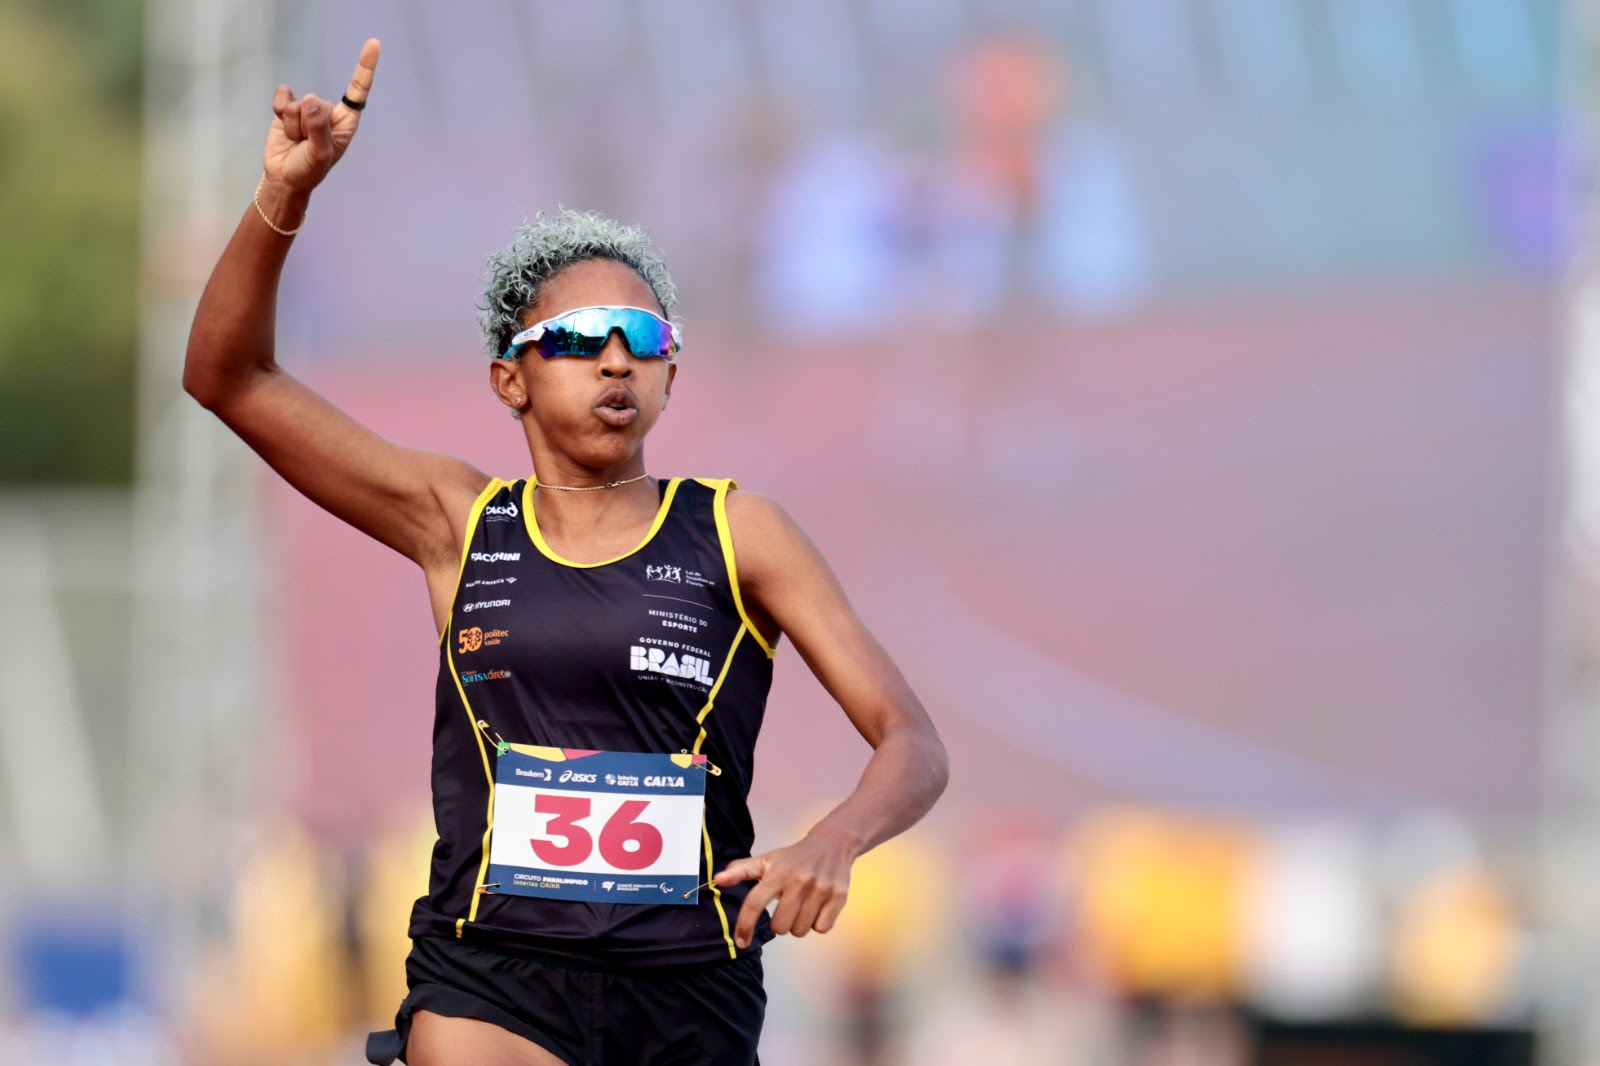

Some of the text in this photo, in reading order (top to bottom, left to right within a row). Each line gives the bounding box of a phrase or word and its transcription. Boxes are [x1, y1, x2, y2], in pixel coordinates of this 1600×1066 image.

[475, 600, 510, 610] HYUNDAI
[662, 620, 698, 633] ESPORTE
[458, 626, 482, 654] 50
[484, 629, 509, 640] politec
[640, 637, 711, 657] GOVERNO FEDERAL
[630, 646, 714, 686] BRASIL
[644, 776, 684, 787] CAIXA
[530, 794, 663, 870] 36
[514, 874, 542, 882] CIRCUITO
